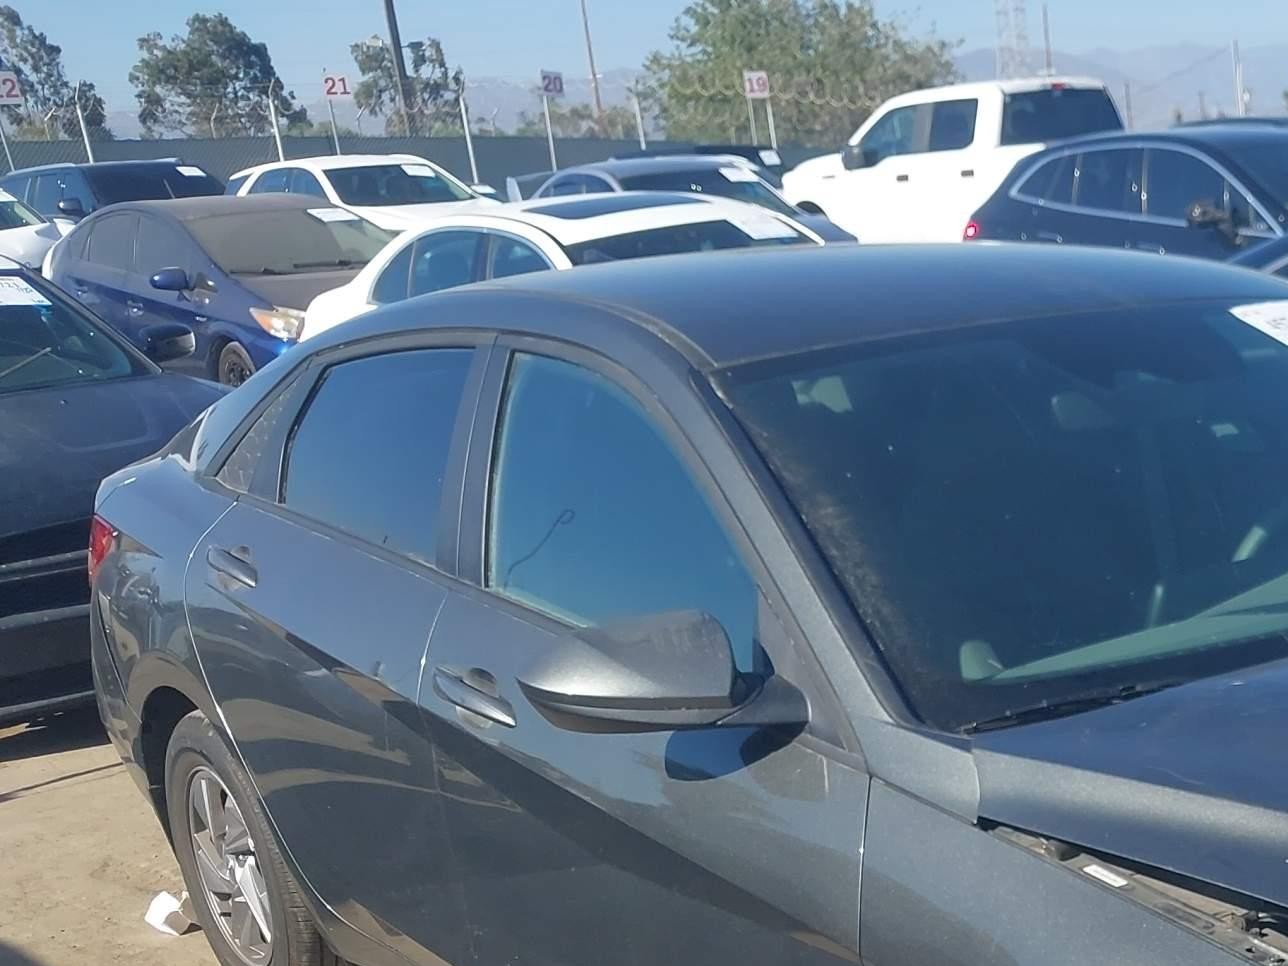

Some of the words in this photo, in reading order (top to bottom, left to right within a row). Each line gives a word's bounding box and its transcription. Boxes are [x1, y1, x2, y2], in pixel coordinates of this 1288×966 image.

[0, 78, 20, 98] 2
[324, 77, 352, 96] 21
[542, 75, 564, 94] 20
[747, 76, 768, 93] 19
